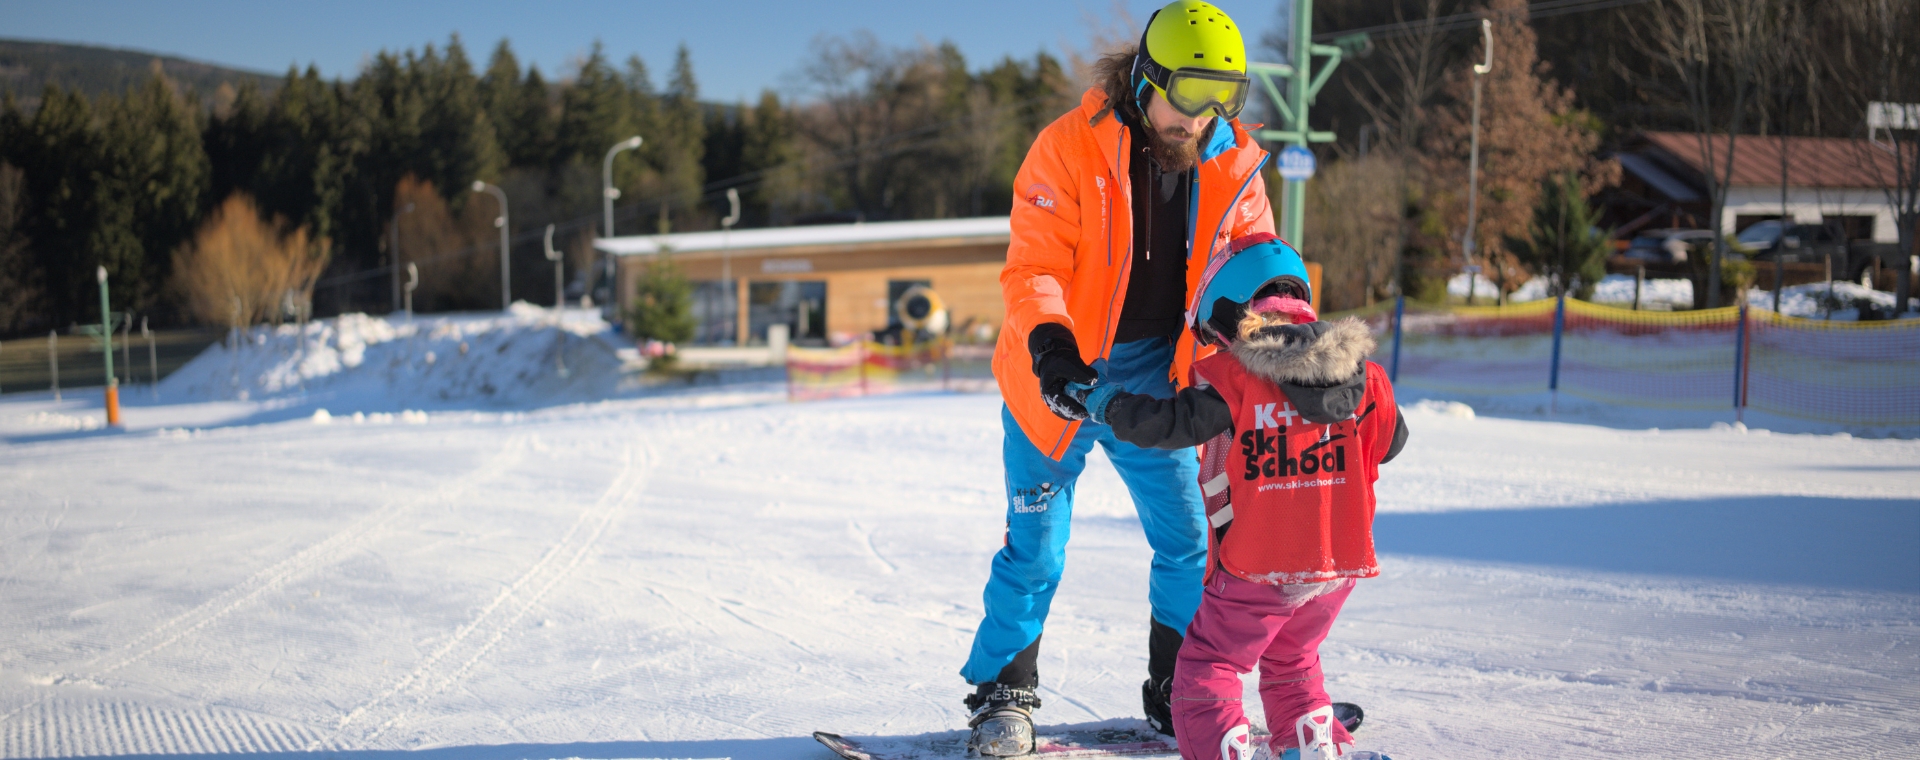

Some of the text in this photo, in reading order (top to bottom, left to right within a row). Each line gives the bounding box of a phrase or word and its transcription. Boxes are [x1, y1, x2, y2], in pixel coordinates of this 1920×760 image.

[1254, 401, 1312, 430] K+
[1244, 446, 1346, 481] School
[1258, 477, 1346, 492] www.ski-school.cz
